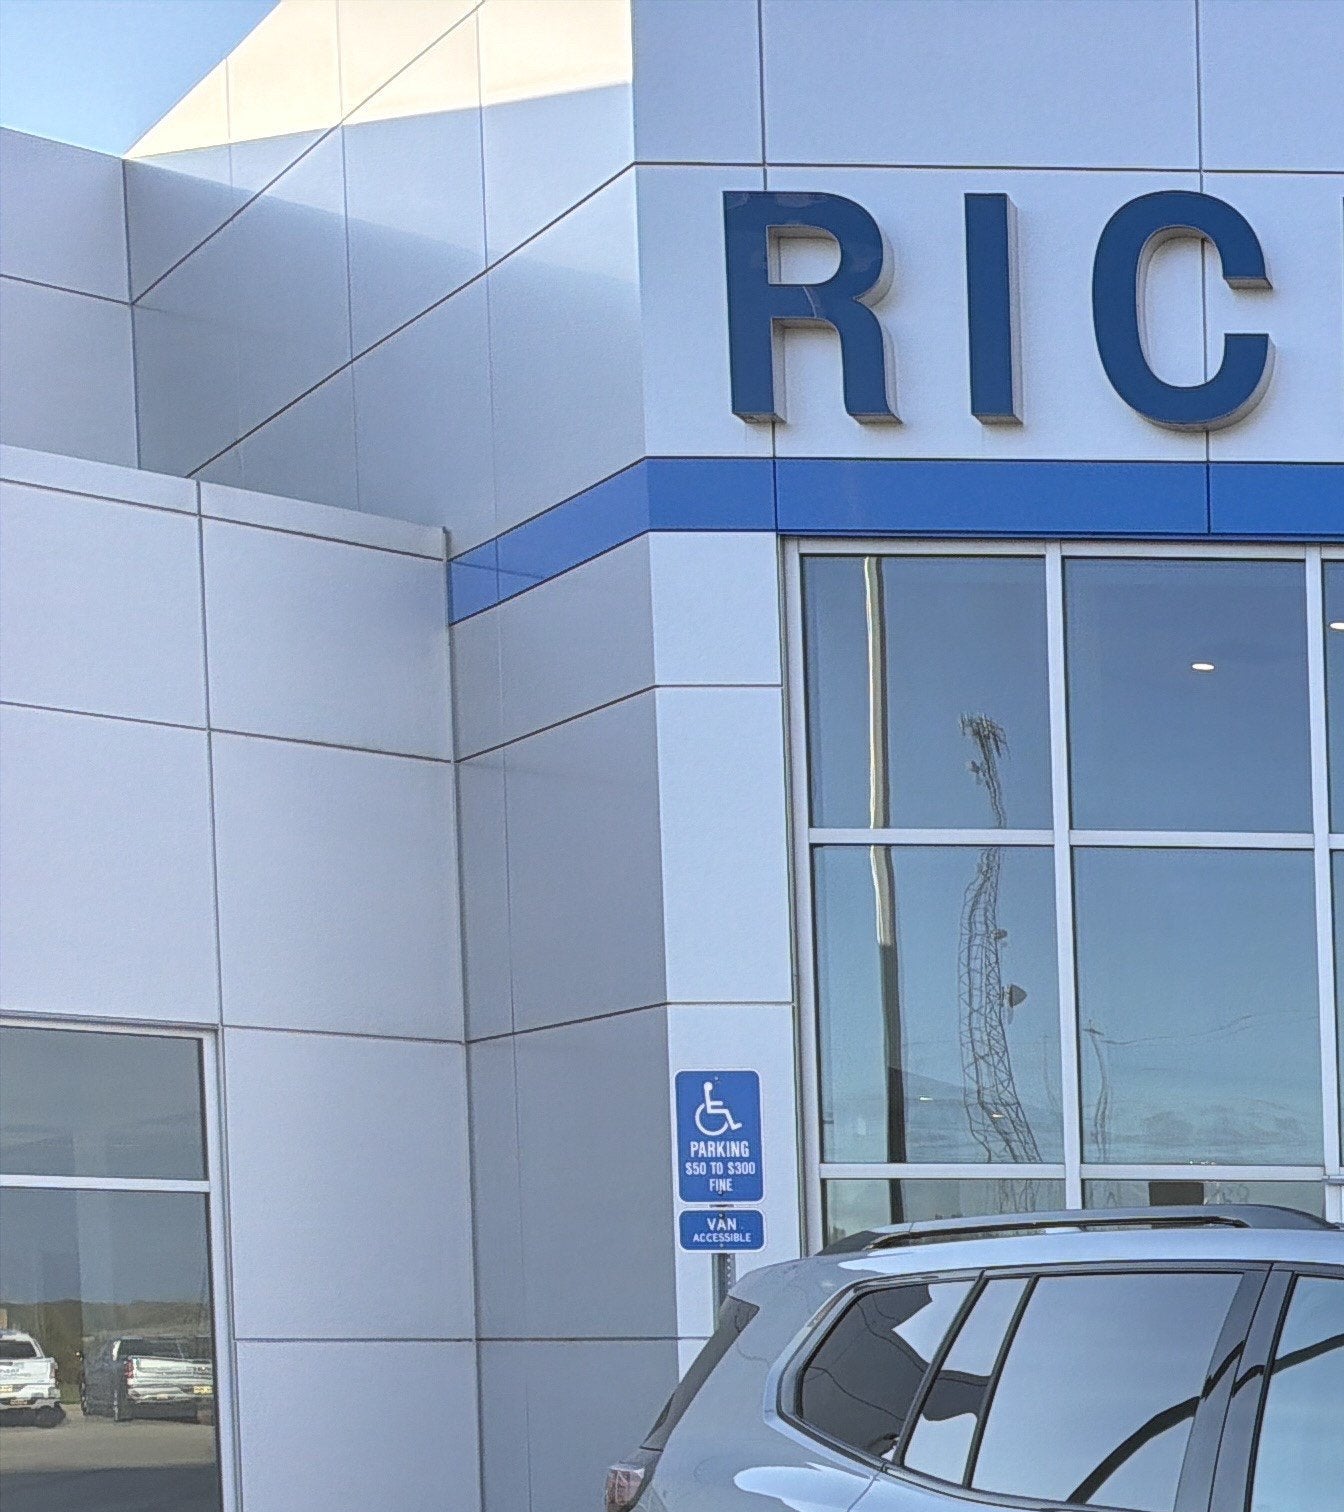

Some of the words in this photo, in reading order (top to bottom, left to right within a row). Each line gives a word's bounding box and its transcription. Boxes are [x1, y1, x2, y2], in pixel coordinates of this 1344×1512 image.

[690, 1140, 750, 1158] PARKING
[685, 1161, 707, 1176] $50
[709, 1161, 723, 1175] TO
[727, 1161, 756, 1176] $300
[709, 1178, 733, 1192] FINE
[707, 1217, 737, 1231] VAN
[692, 1232, 752, 1243] ACCESSIBLE
